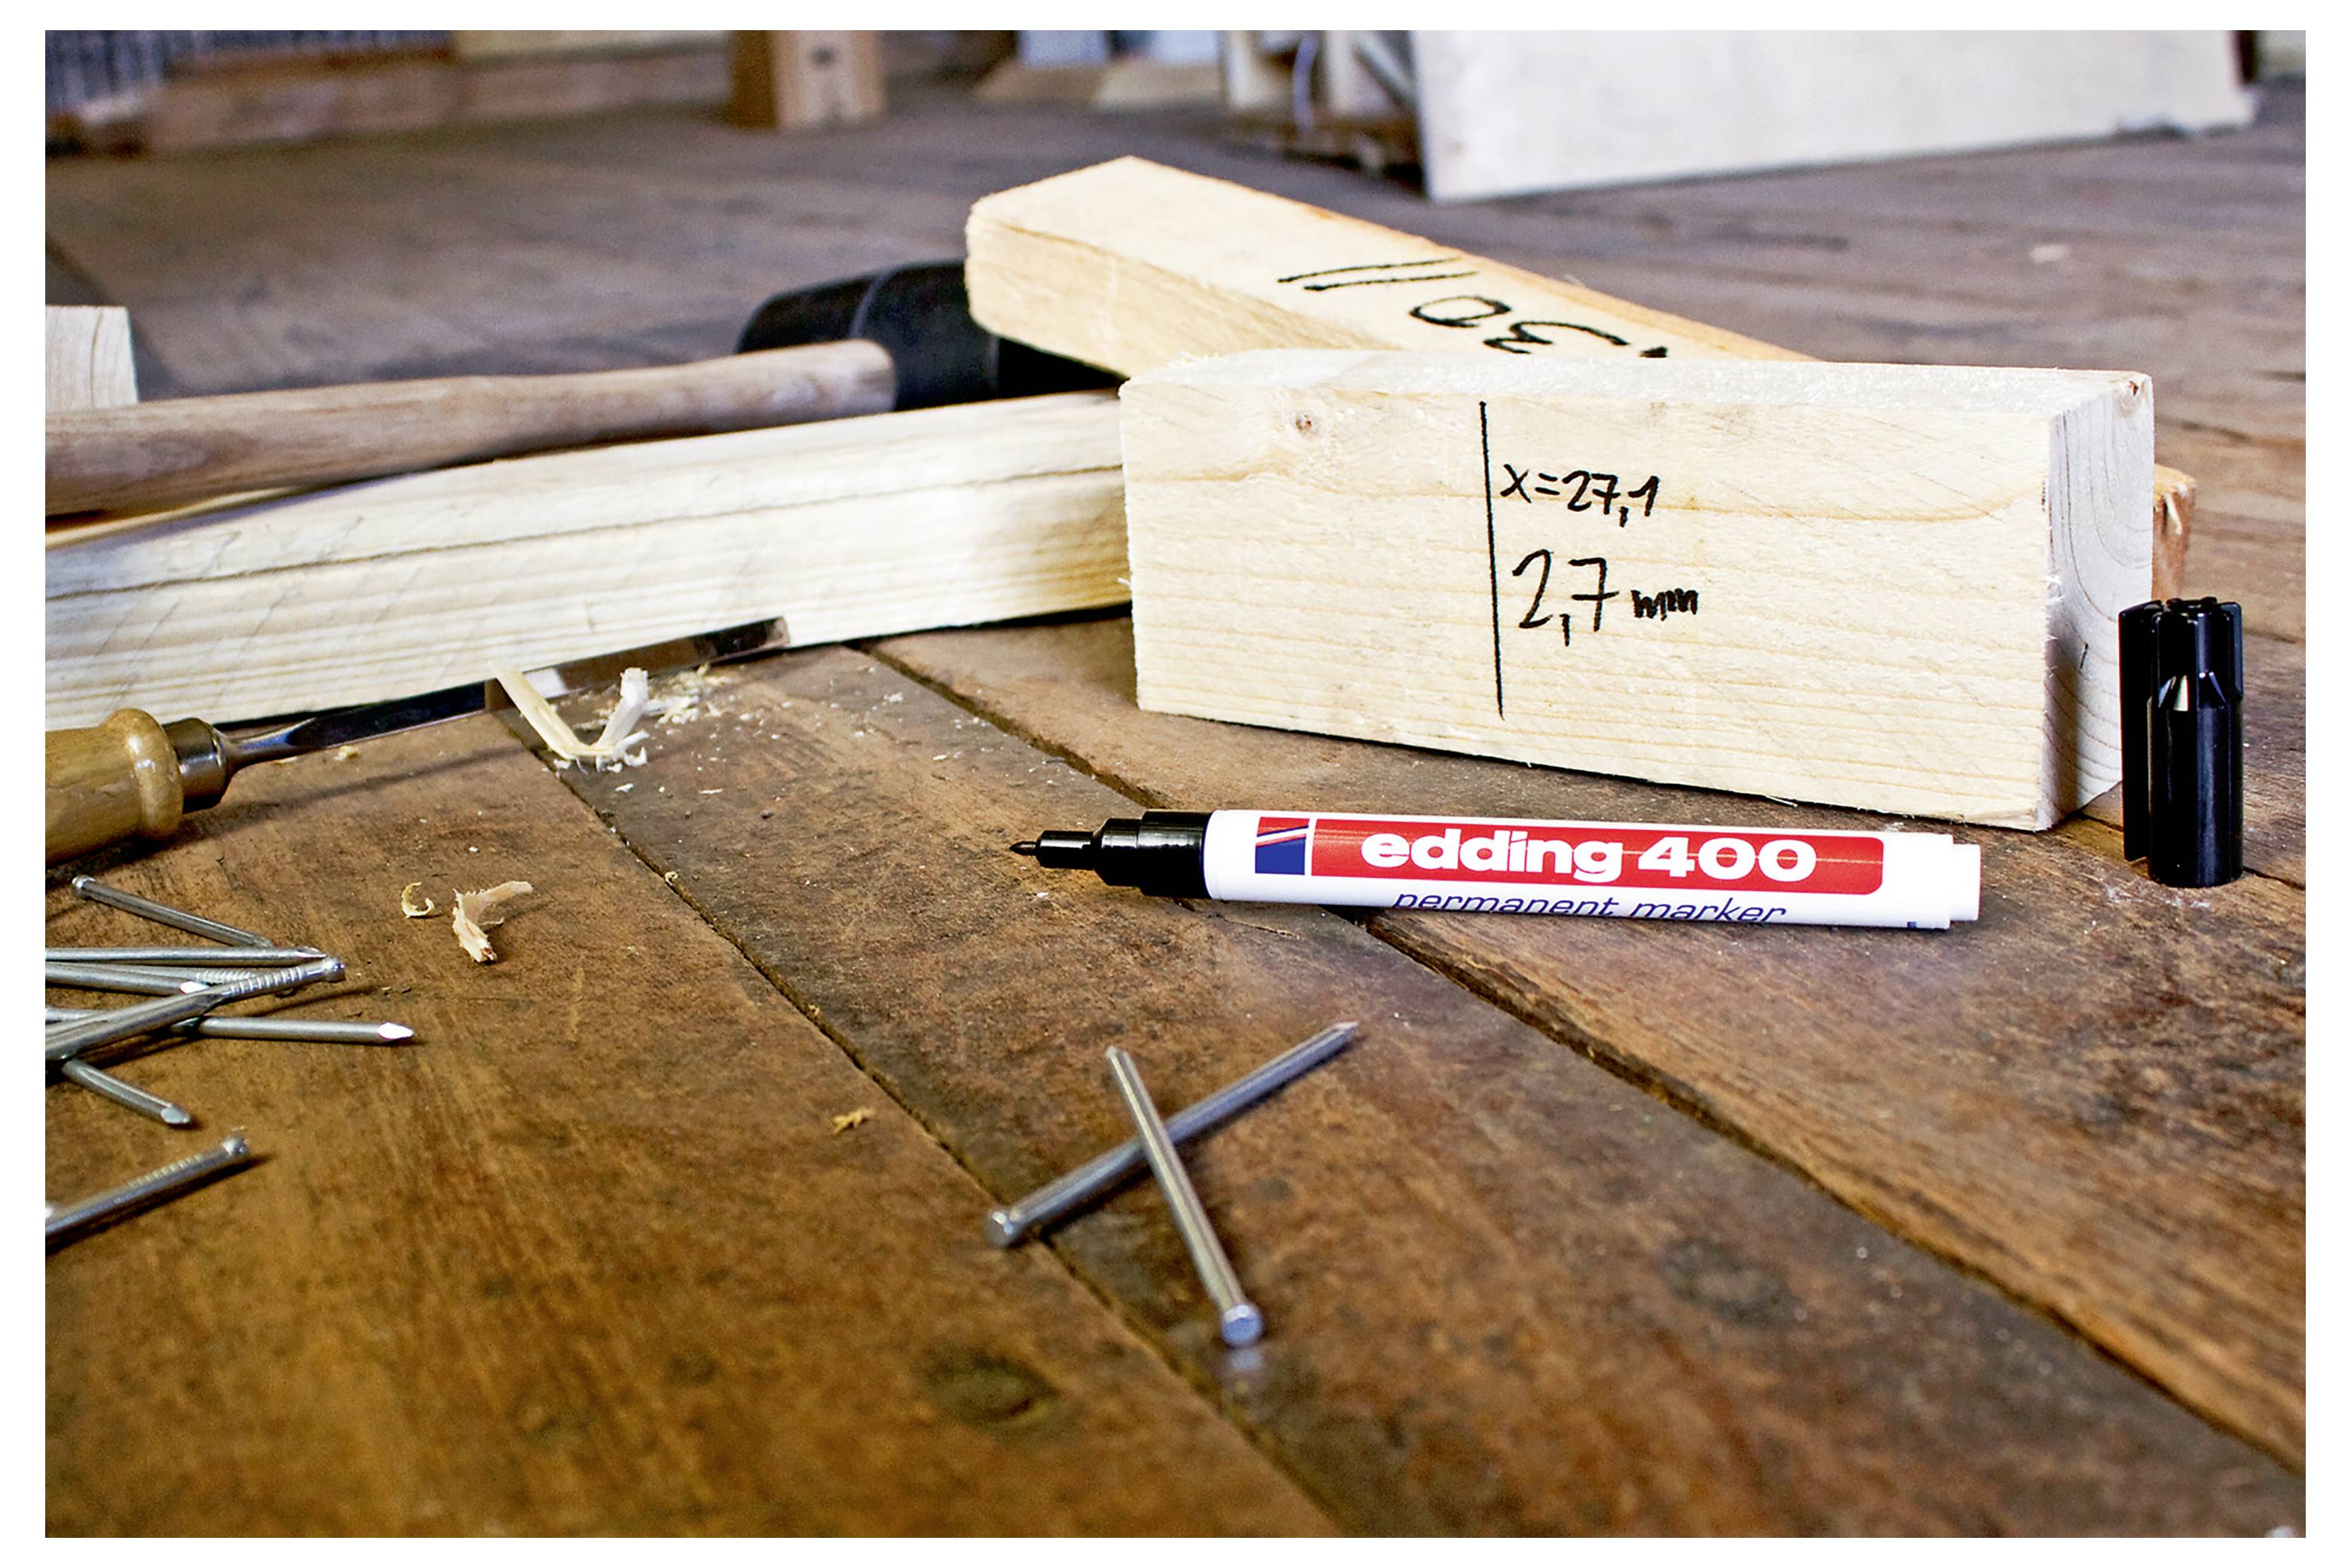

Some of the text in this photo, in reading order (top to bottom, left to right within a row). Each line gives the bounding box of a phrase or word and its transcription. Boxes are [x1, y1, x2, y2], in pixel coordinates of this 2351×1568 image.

[1512, 549, 1620, 647] 2,7
[1360, 828, 1817, 883] edding 400
[1392, 893, 1786, 922] permanent marker
